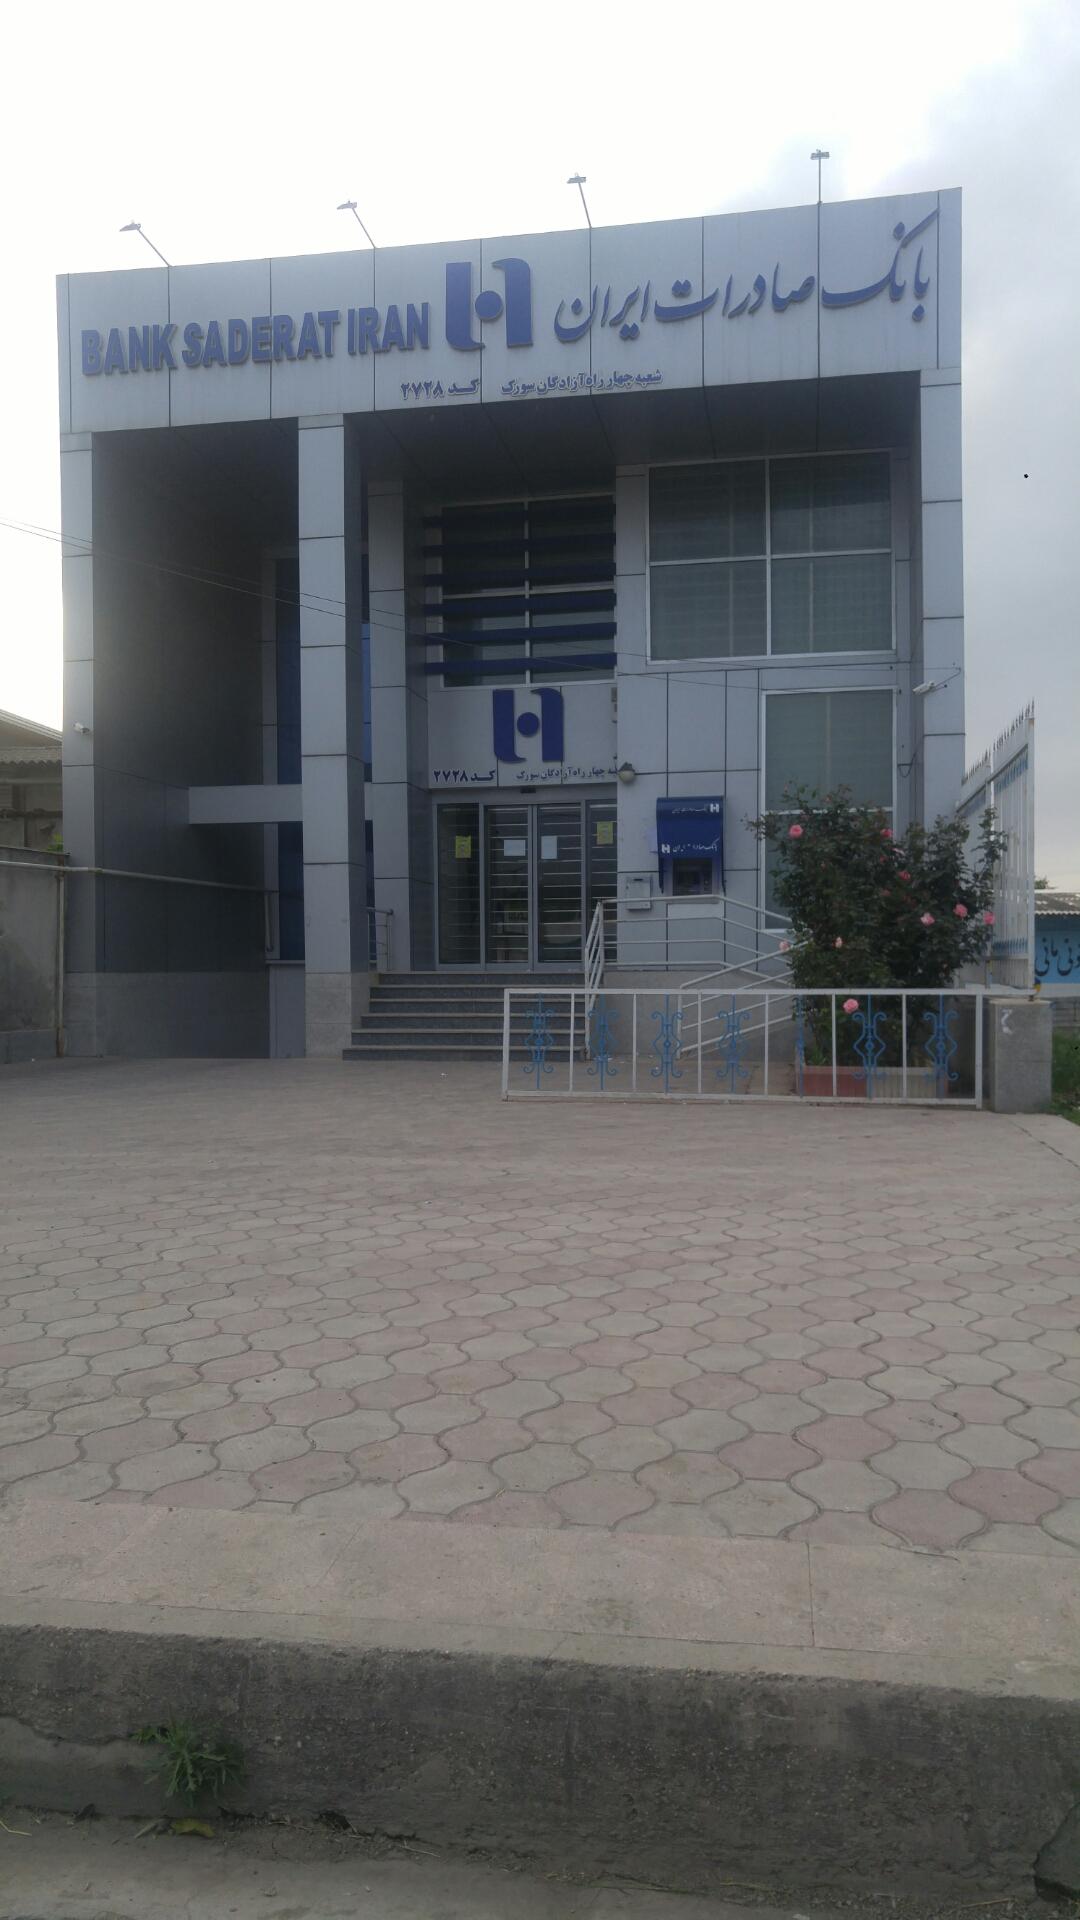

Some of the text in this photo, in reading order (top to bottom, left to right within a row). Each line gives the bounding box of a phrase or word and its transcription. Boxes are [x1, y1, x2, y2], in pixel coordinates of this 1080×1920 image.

[554, 207, 940, 343] بانک صادرات ایران
[82, 302, 430, 376] BANK SADERAT IRAN
[537, 372, 586, 395] آزادگان
[636, 368, 663, 386] شعبه
[447, 378, 480, 396] کد
[501, 378, 536, 396] سورک
[470, 769, 496, 783] کد
